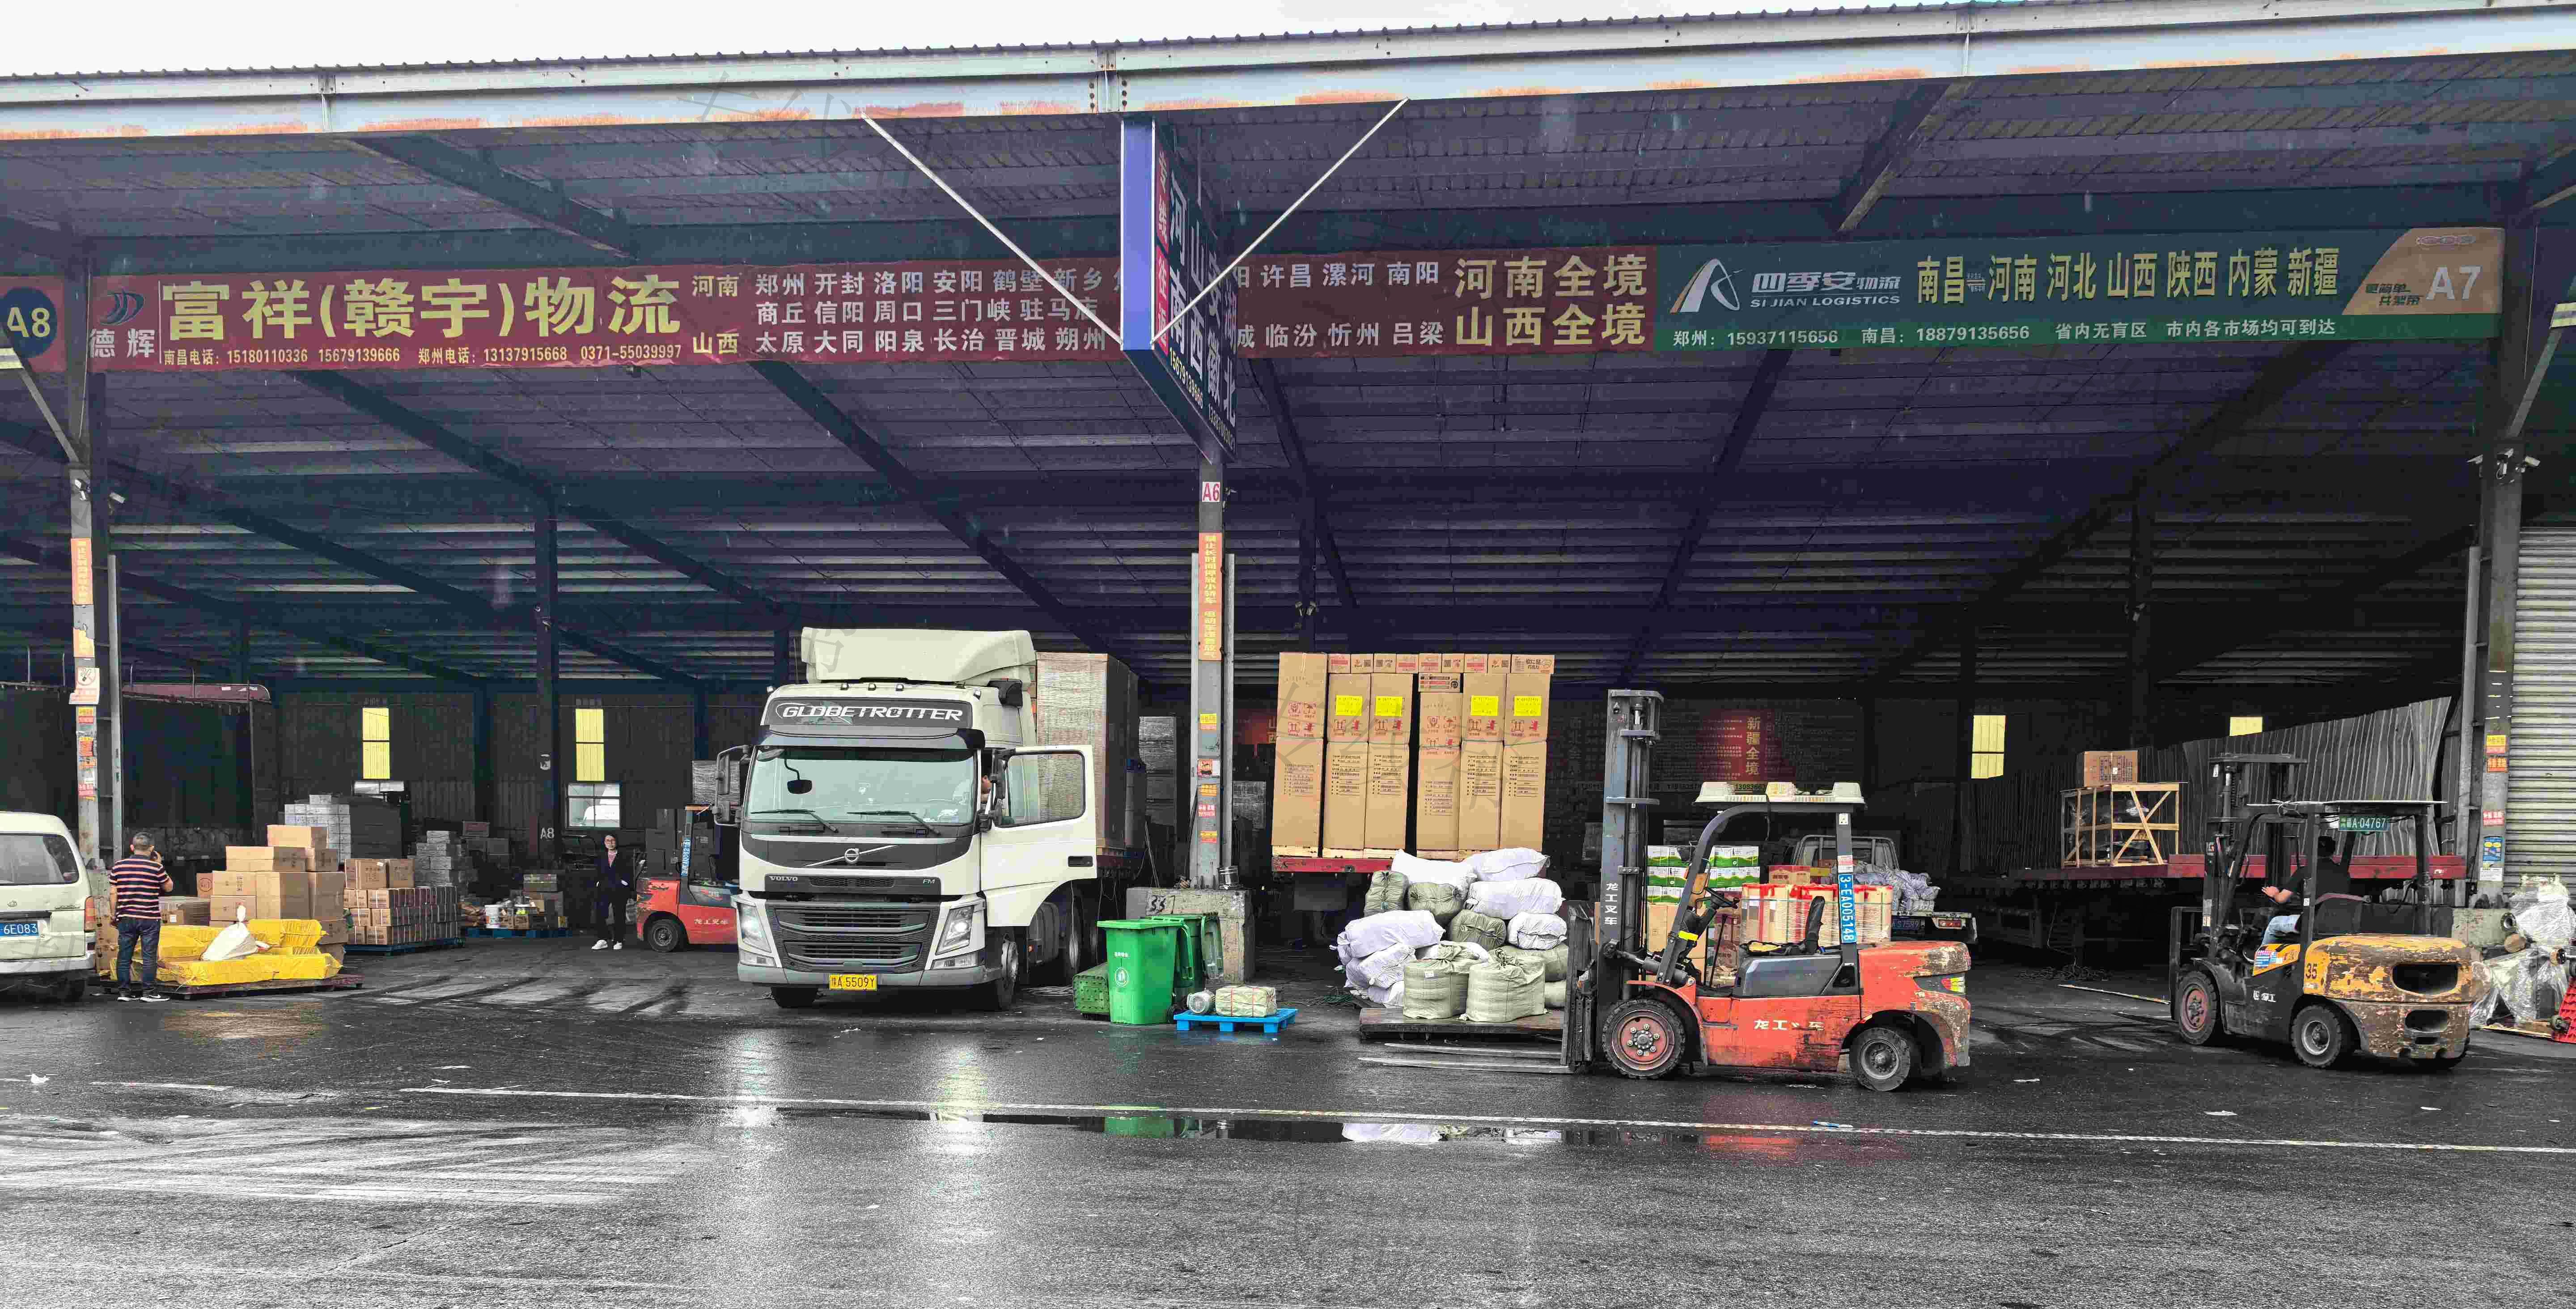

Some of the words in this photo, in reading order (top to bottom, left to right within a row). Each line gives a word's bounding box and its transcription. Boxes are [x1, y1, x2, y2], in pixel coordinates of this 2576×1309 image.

[1170, 169, 1187, 354] 河南
[1260, 264, 1311, 288] 许昌
[1322, 262, 1375, 286] 漯河
[1387, 261, 1439, 286] 南阳
[1917, 255, 1965, 305] 南昌
[1988, 253, 2037, 303] 河南
[2046, 251, 2097, 302] 河北
[2107, 251, 2158, 298] 山西
[2166, 250, 2218, 298] 陕西
[2228, 247, 2279, 298] 内蒙
[2287, 246, 2340, 297] 新疆
[692, 275, 739, 297] 河南
[756, 273, 805, 295] 郑州
[815, 272, 864, 295] 开封
[874, 271, 923, 294] 洛阳
[933, 270, 983, 293] 安阳
[993, 269, 1043, 293] 鹤壁
[1053, 268, 1103, 292] 新乡
[1454, 253, 1648, 299] 河南全境
[2426, 265, 2483, 301] A7
[756, 301, 806, 326] 商丘
[815, 301, 864, 325] 信阳
[873, 300, 923, 323] 周口
[933, 298, 1011, 323] 三门峡
[1020, 298, 1098, 322] 驻马店
[1191, 219, 1204, 380] 山西
[1770, 297, 1807, 308] JIAN
[1812, 295, 1900, 307] LOGISTICS
[6, 306, 51, 338] A8
[1265, 323, 1317, 348] 临汾
[1327, 323, 1380, 347] 忻州
[1392, 320, 1444, 345] 吕梁
[1456, 302, 1647, 347] 山西全境
[1727, 329, 1839, 346] 15937115656
[1916, 326, 2030, 342] 18879135656
[2166, 318, 2336, 338] 市内各市场均可到达
[90, 328, 155, 358] 德辉
[693, 332, 739, 355] 山西
[756, 331, 804, 353] 太原
[814, 330, 863, 353] 大同
[875, 329, 925, 353] 阳泉
[934, 328, 984, 352] 长治
[995, 327, 1046, 352] 晋城
[1055, 327, 1106, 351] 朔州
[226, 348, 308, 365] 15180110336
[318, 347, 400, 364] 15679139666
[483, 346, 567, 362] 13137915668
[580, 344, 682, 361] 0371-55039997
[1202, 482, 1220, 502] A6
[782, 706, 963, 721] GLOBETROTTER
[1746, 715, 1761, 776] 新疆全境
[540, 827, 555, 839] A8
[1604, 882, 1619, 926] 龙工叉车
[1840, 876, 1855, 942] 3-EA005148
[2305, 963, 2318, 979] 35
